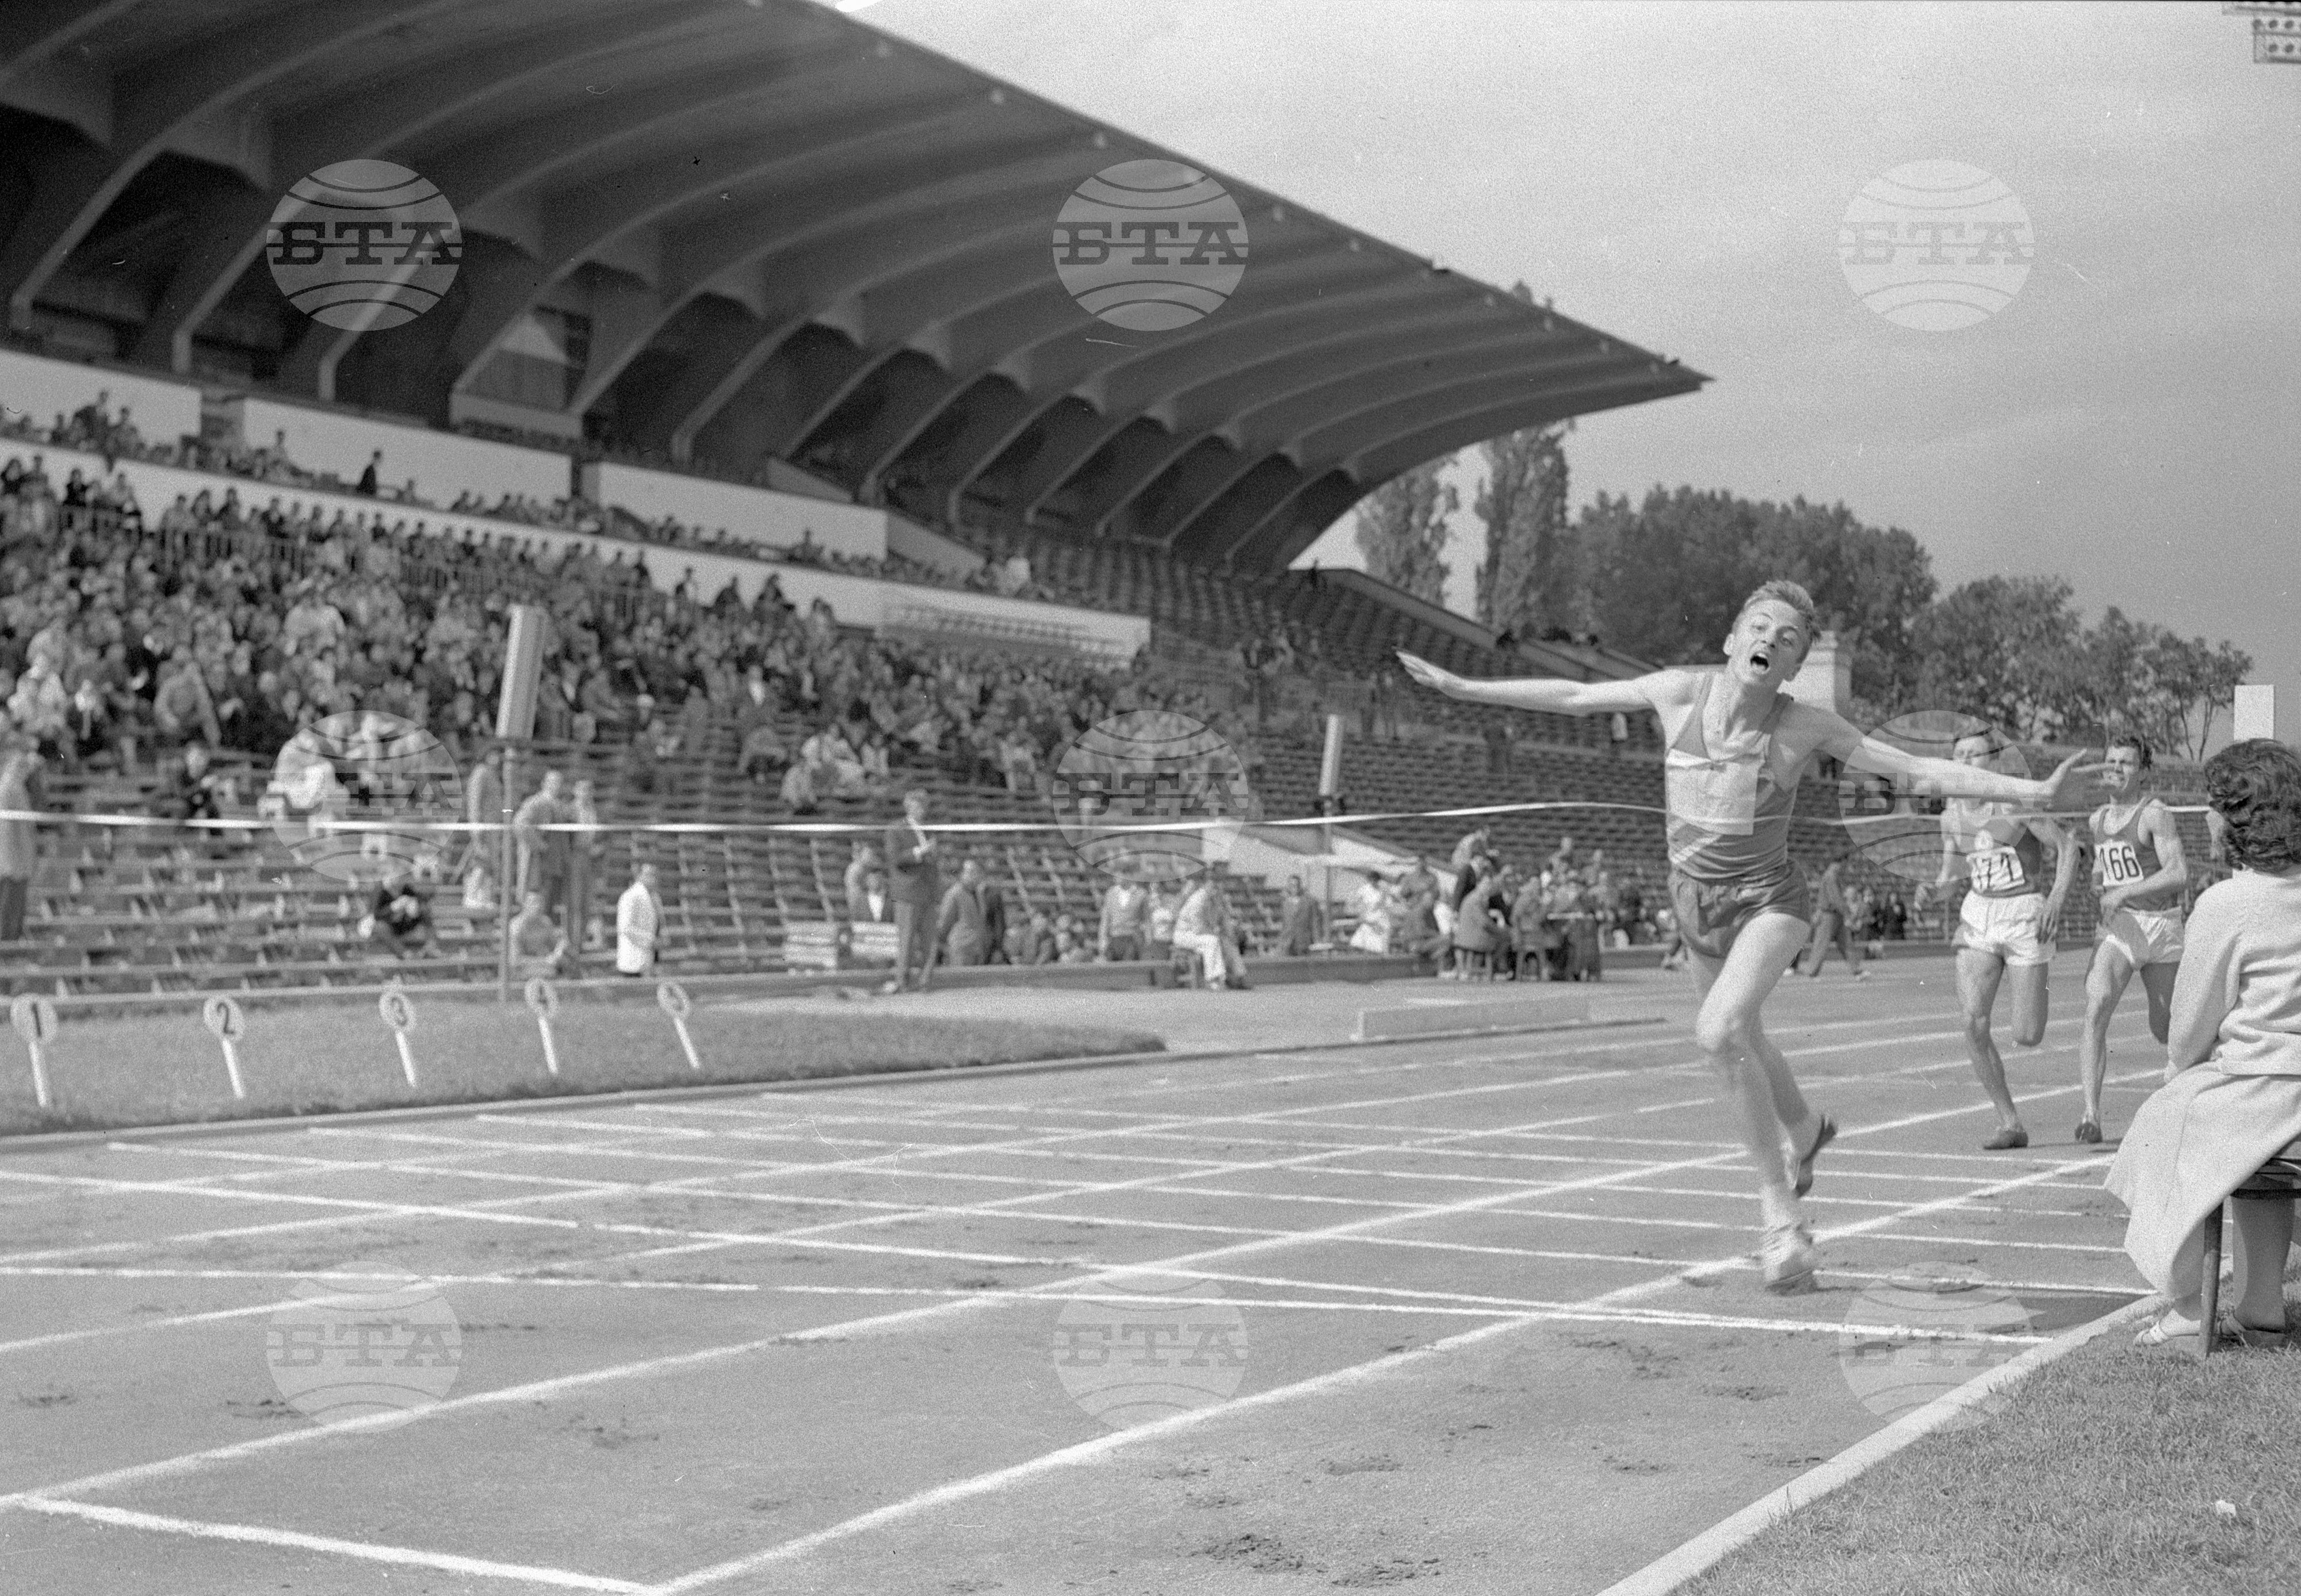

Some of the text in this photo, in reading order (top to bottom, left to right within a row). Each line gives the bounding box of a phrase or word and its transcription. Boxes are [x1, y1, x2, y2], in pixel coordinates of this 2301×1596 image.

[2099, 847, 2140, 881] 166
[30, 1002, 43, 1038] 1
[216, 1001, 236, 1035] 2
